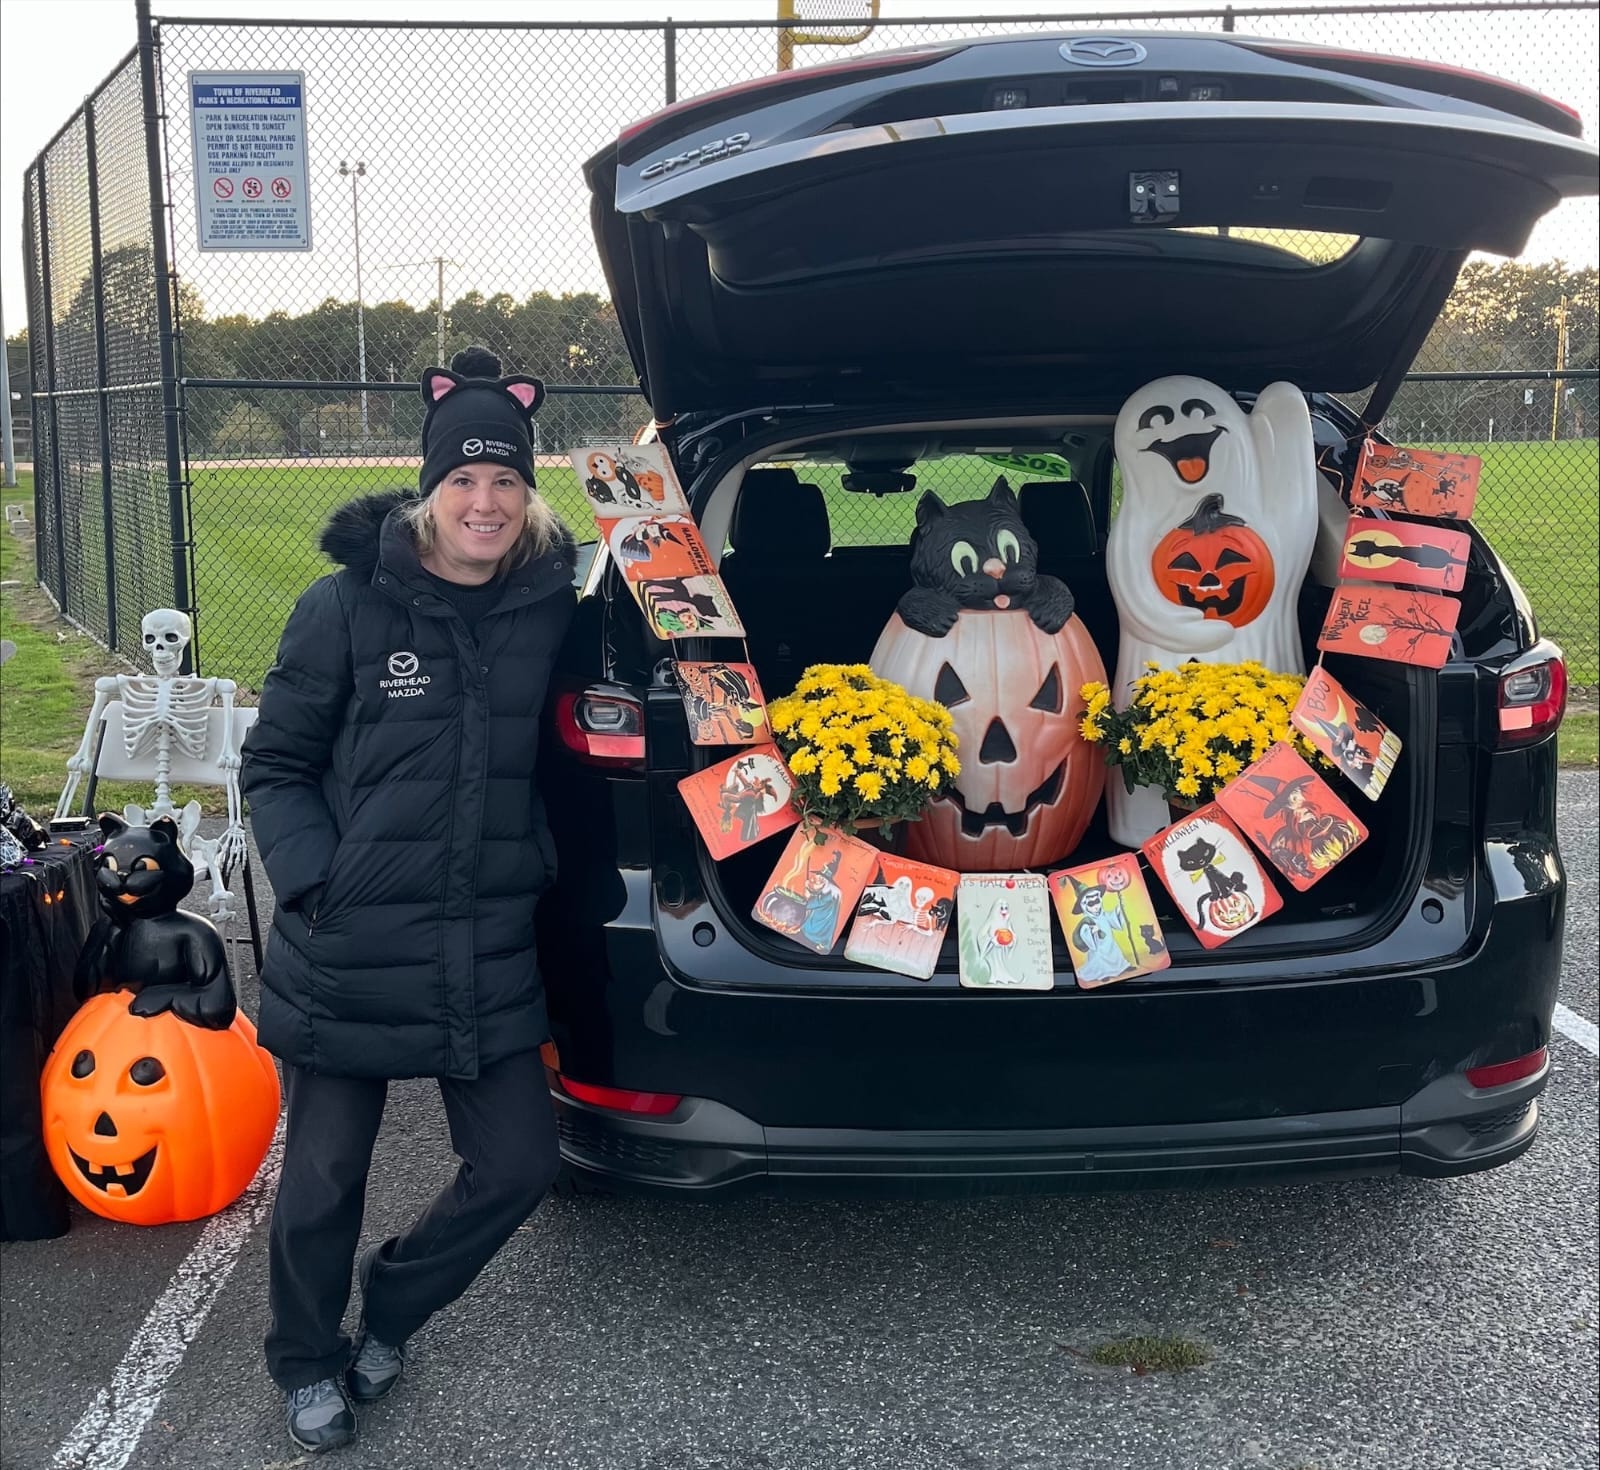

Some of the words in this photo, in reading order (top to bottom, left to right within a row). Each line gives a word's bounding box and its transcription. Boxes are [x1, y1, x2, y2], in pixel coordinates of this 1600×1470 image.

[213, 88, 233, 96] TOWN
[235, 88, 243, 96] OF
[245, 88, 281, 96] RIVERHEAD
[485, 440, 518, 452] RIVERHEAD
[486, 447, 510, 456] MAZDA
[681, 527, 710, 575] HALLOWEEN
[1325, 597, 1353, 641] HALLOWEEN
[1348, 597, 1372, 625] TREE
[379, 675, 431, 688] RIVERHEAD
[387, 687, 425, 698] MAZDA
[1307, 680, 1331, 712] BOO
[1156, 821, 1200, 851] HALLOWEEN
